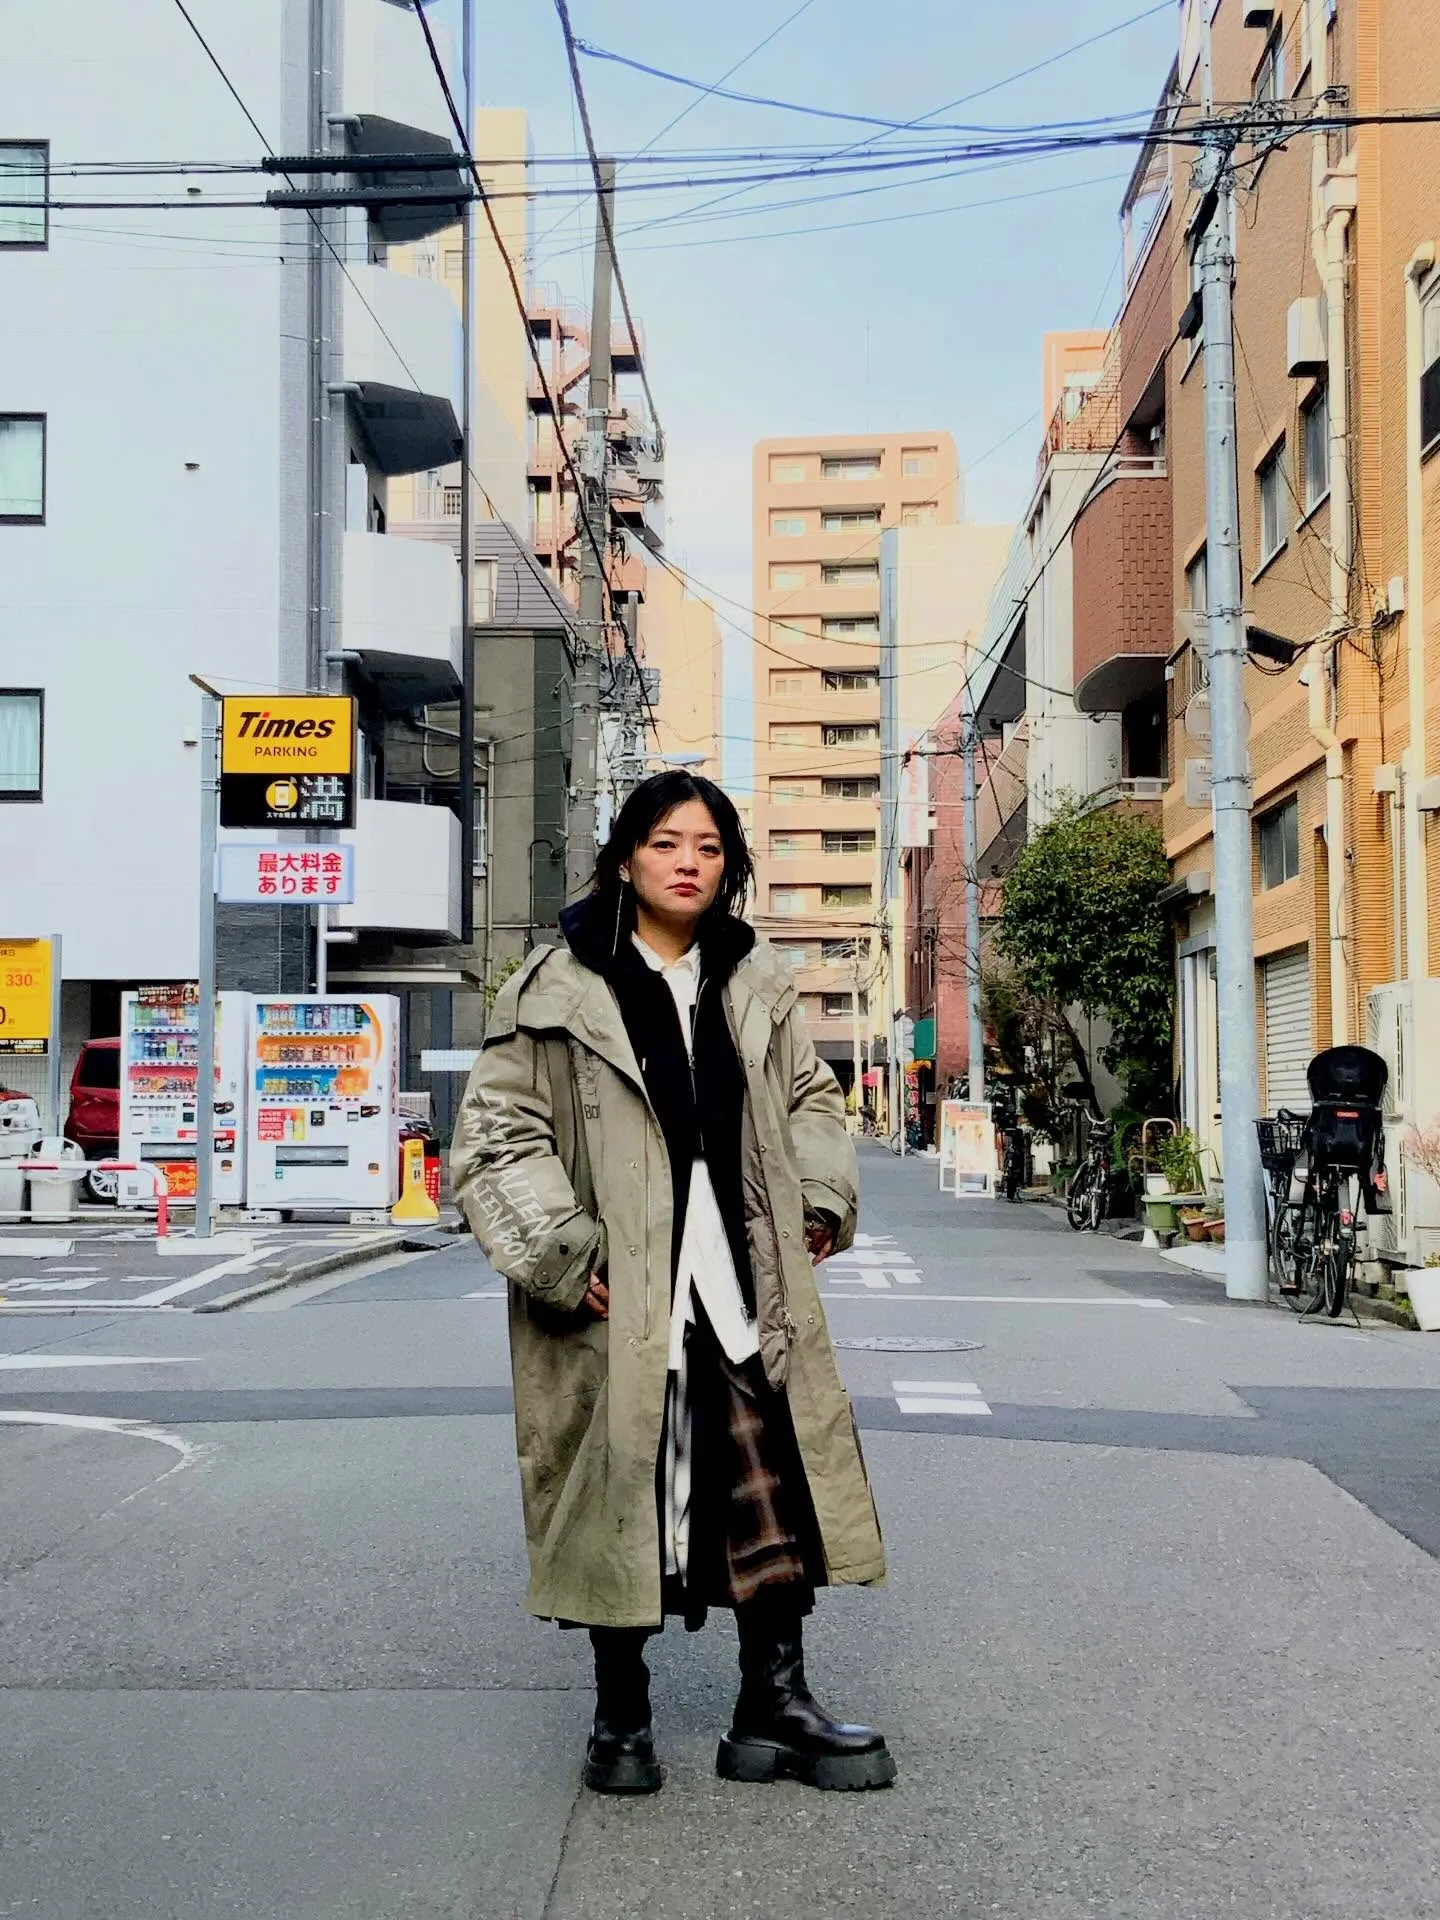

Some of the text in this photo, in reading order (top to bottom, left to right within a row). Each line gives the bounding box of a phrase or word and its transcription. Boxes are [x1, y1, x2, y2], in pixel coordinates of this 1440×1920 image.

[237, 711, 336, 739] Times
[254, 746, 318, 757] PARKING
[301, 775, 346, 821] 満
[258, 852, 342, 873] 最大料金
[258, 876, 342, 894] あります
[6, 974, 33, 987] 330
[471, 1173, 514, 1234] LIEN
[497, 1166, 553, 1241] ALIEN
[491, 1225, 539, 1270] BOY
